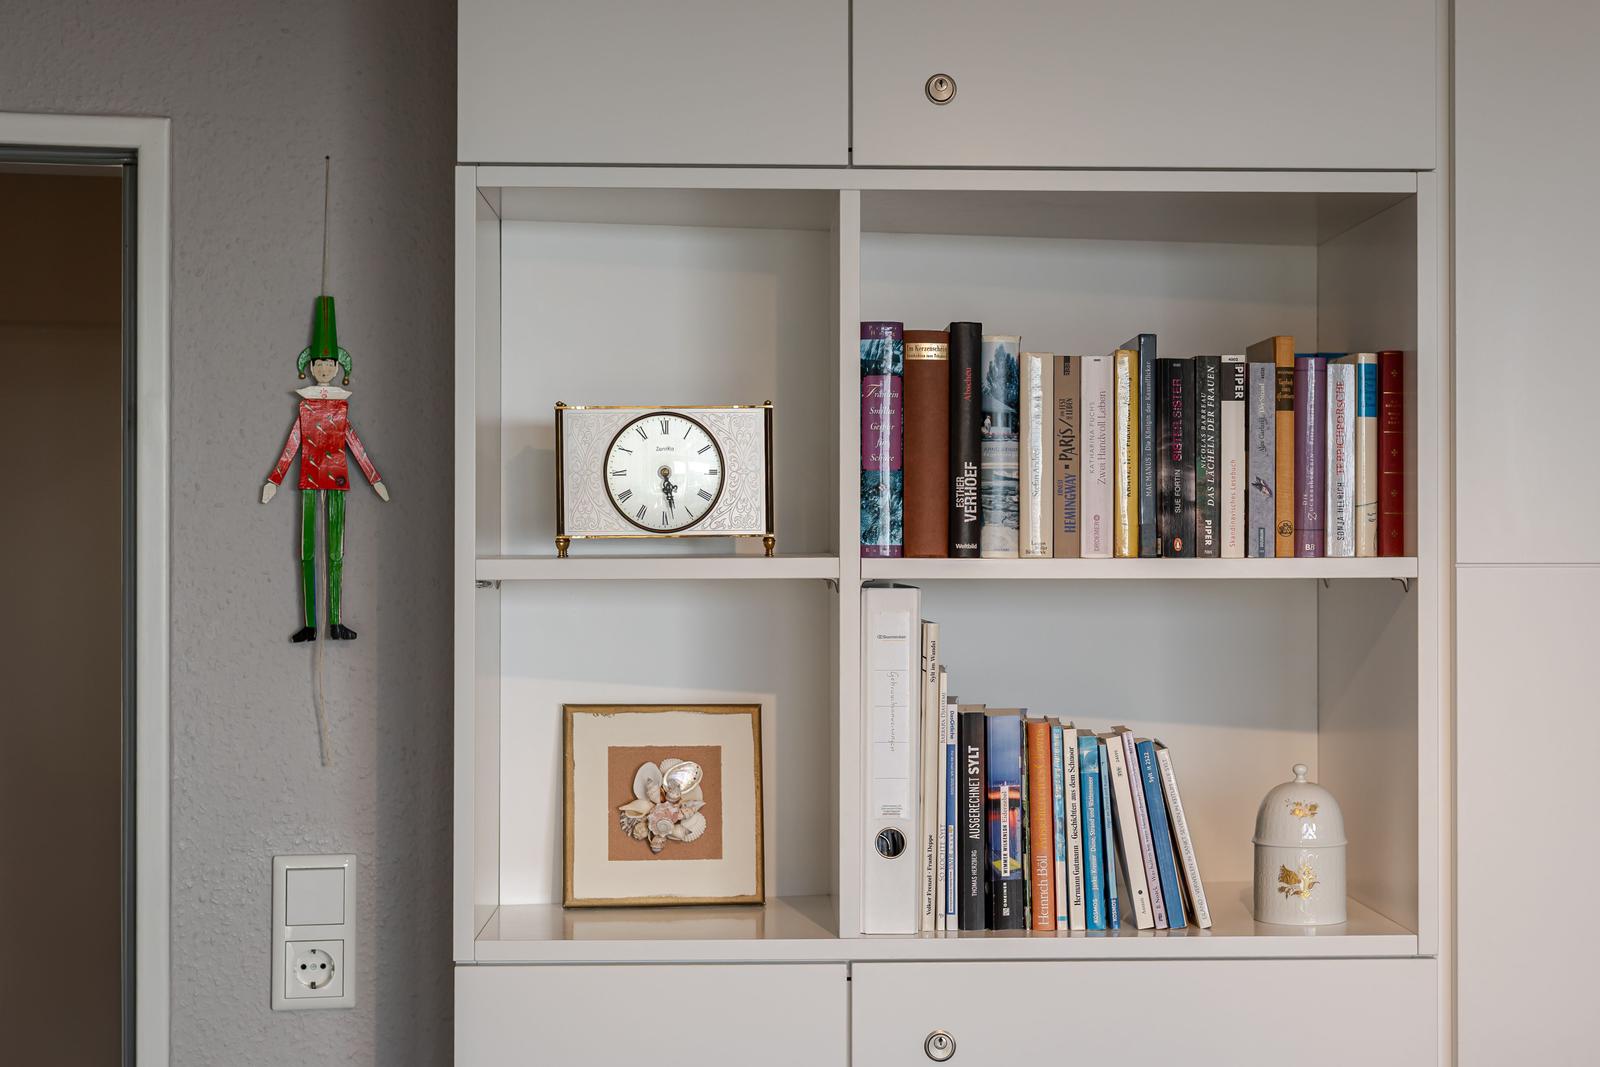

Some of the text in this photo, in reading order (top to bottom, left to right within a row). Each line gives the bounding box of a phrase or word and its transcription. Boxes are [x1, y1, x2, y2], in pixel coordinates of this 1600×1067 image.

[963, 367, 972, 401] Abscheu
[1234, 365, 1244, 399] PIPER
[1088, 401, 1096, 474] KATHARINA FUCHS
[1097, 390, 1107, 485] Zwei Handvoll Leben
[1205, 365, 1216, 507] DAS LÄCHELN DER FRAUEN
[955, 461, 978, 523] ESTHER VERHOEF
[1064, 472, 1077, 533] HEMINGWAY
[1174, 469, 1182, 514] SUE FORTIN
[1228, 459, 1237, 548] Skandinavisches Lesebuch
[1204, 519, 1212, 546] PIPER
[1336, 516, 1345, 541] SONJA
[929, 671, 937, 683] Sylt
[1067, 746, 1075, 773] Schnoor
[1143, 752, 1151, 765] 2522
[967, 745, 981, 839] AUSGERECHNET SYLT
[1068, 774, 1076, 789] dem
[1147, 772, 1155, 783] Sylt
[1069, 802, 1078, 840] Geschichten
[1088, 818, 1096, 836] Strand
[926, 834, 934, 853] Deppe
[1034, 855, 1048, 877] Böll
[1071, 845, 1080, 876] Gutmann
[1036, 879, 1050, 926] Heinrich
[1071, 875, 1081, 907] Hermann
[1110, 899, 1118, 922] KOSMOS
